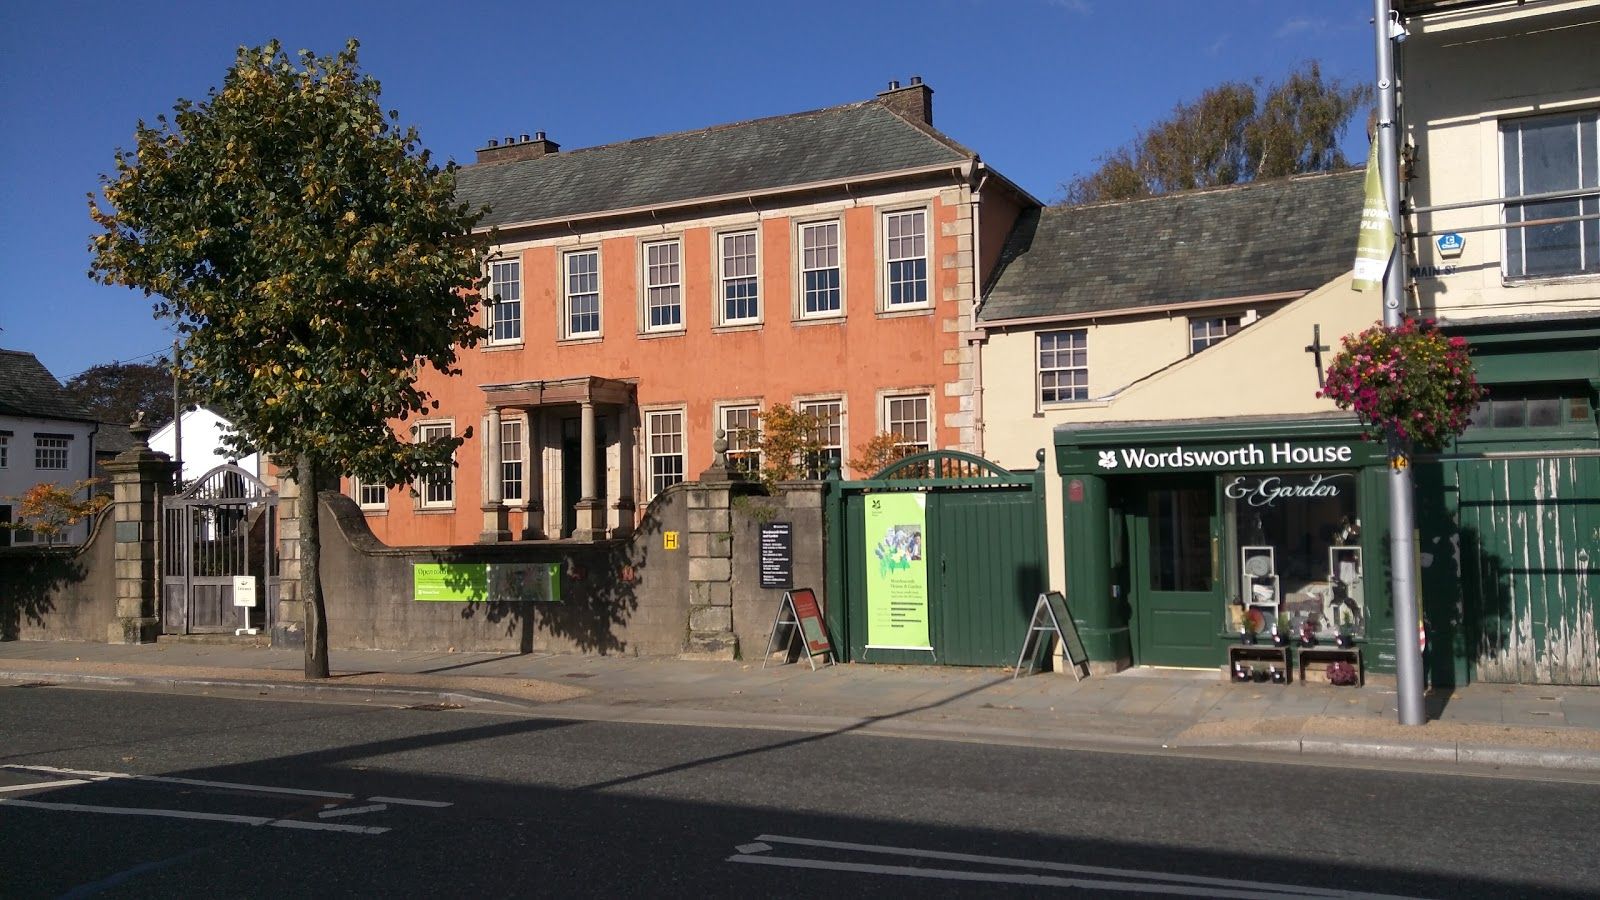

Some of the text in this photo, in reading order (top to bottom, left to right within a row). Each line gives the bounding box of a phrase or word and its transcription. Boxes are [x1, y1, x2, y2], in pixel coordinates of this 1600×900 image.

[1410, 265, 1456, 277] MAIN ST
[1121, 442, 1352, 468] Wordsworth House
[1248, 474, 1353, 507] Garden
[666, 534, 675, 547] H
[418, 568, 433, 576] Open
